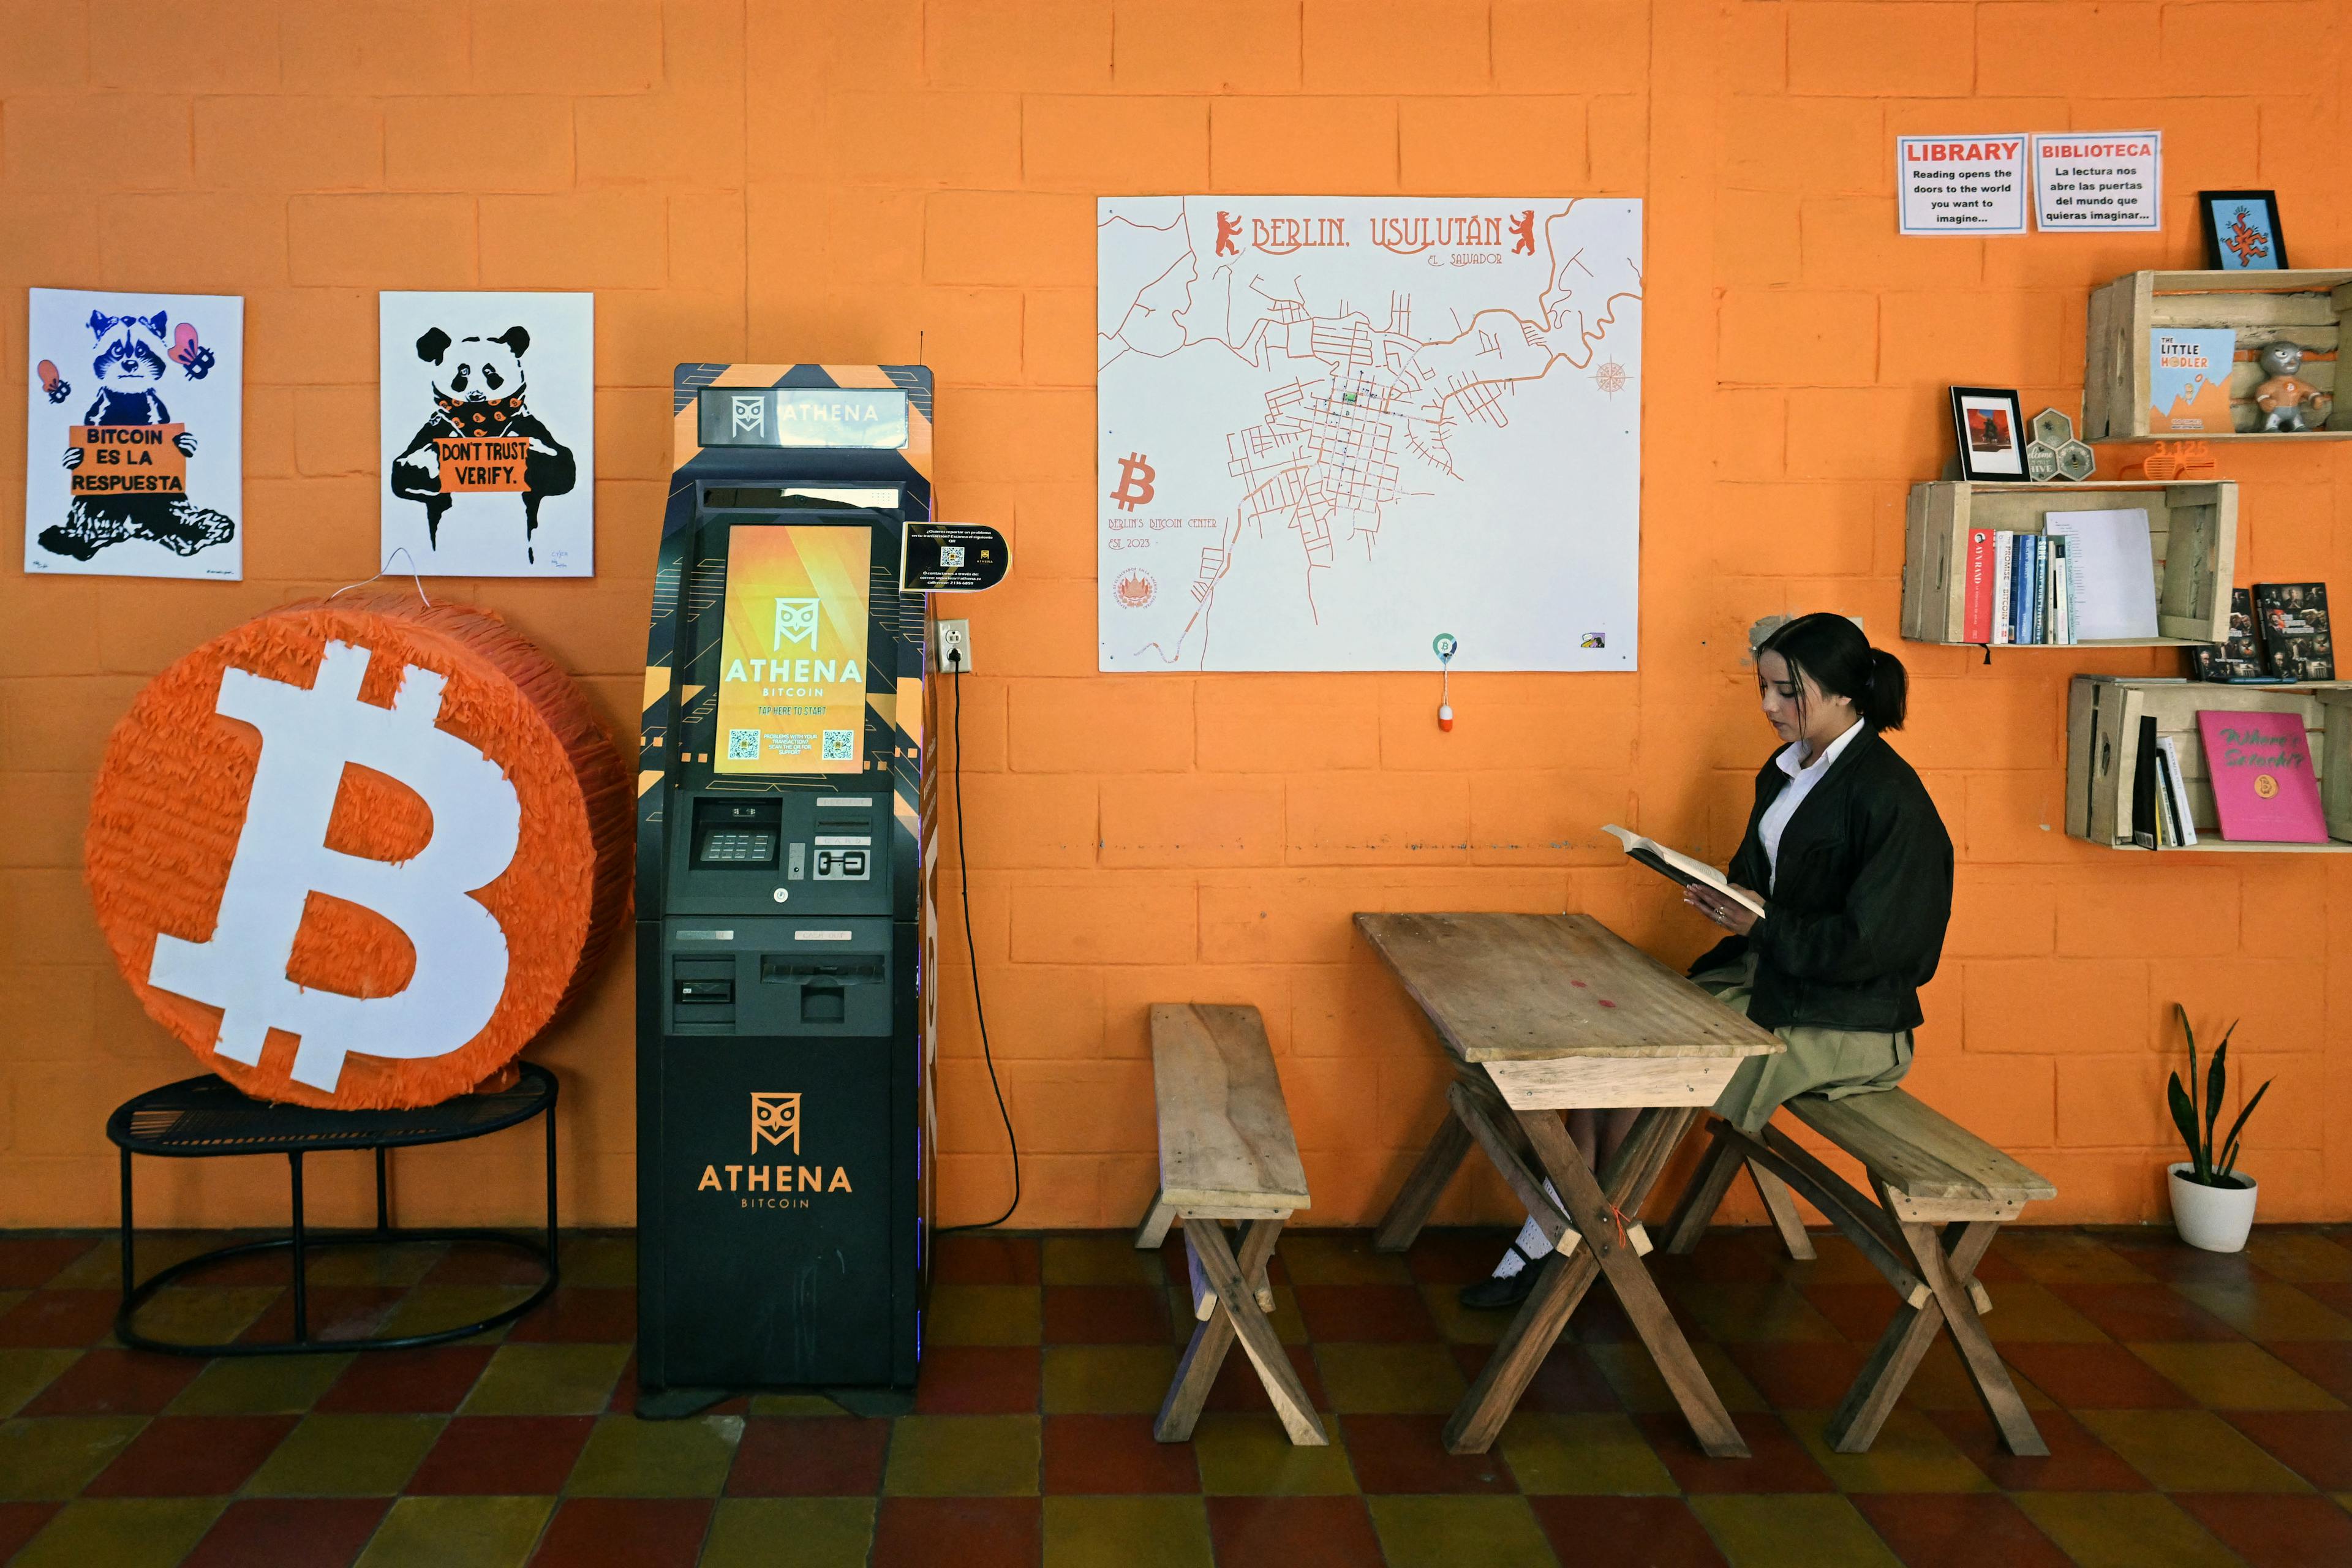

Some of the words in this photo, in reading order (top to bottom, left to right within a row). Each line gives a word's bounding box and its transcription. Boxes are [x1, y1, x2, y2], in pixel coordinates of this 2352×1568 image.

[1907, 142, 2019, 161] LIBRARY
[2042, 143, 2152, 158] BIBLIOTECA
[1913, 170, 1955, 179] Reading
[2056, 167, 2068, 176] La
[2073, 167, 2113, 176] lectura
[1913, 184, 1943, 193] doors
[1960, 184, 1978, 193] the
[1981, 184, 2011, 192] world
[2050, 182, 2075, 191] abre
[2079, 182, 2095, 190] las
[2099, 182, 2143, 192] puertas
[1931, 201, 1950, 209] you
[2056, 197, 2072, 205] del
[2076, 197, 2113, 205] mundo
[2117, 197, 2138, 206] que
[1937, 214, 1988, 224] imagine...
[2046, 211, 2087, 222] quieras
[2090, 211, 2149, 221] imaginar...
[1370, 215, 1502, 255] USULUTÁN
[1428, 255, 1444, 266] EL
[1450, 254, 1502, 266] SALVADOR
[2161, 345, 2199, 355] LITTLE
[783, 404, 878, 421] ATHENA
[87, 429, 162, 445] BITCOIN
[442, 442, 483, 461] DON'T
[2028, 447, 2052, 458] elcome
[2154, 441, 2207, 456] 3.125
[96, 450, 119, 465] ES
[127, 450, 153, 465] LA
[455, 467, 518, 484] VERIFY.
[72, 475, 183, 491] RESPUESTA
[1108, 518, 1144, 530] BERLIN'S
[1149, 519, 1182, 530] BITCOIN
[1188, 518, 1216, 528] CENTER
[1127, 539, 1150, 548] 2023
[1975, 545, 1983, 559] AYN
[2038, 541, 2047, 560] SONG
[1117, 567, 1137, 579] SALVADOR
[1973, 562, 1982, 584] RAND
[725, 658, 862, 683] ATHENA
[763, 688, 823, 697] BITCOIN
[758, 706, 772, 715] TAP
[774, 706, 791, 715] HERE
[793, 707, 802, 715] TO
[804, 707, 826, 715] START
[698, 1165, 853, 1193] ATHENA
[741, 1198, 809, 1208] BITCOIN
